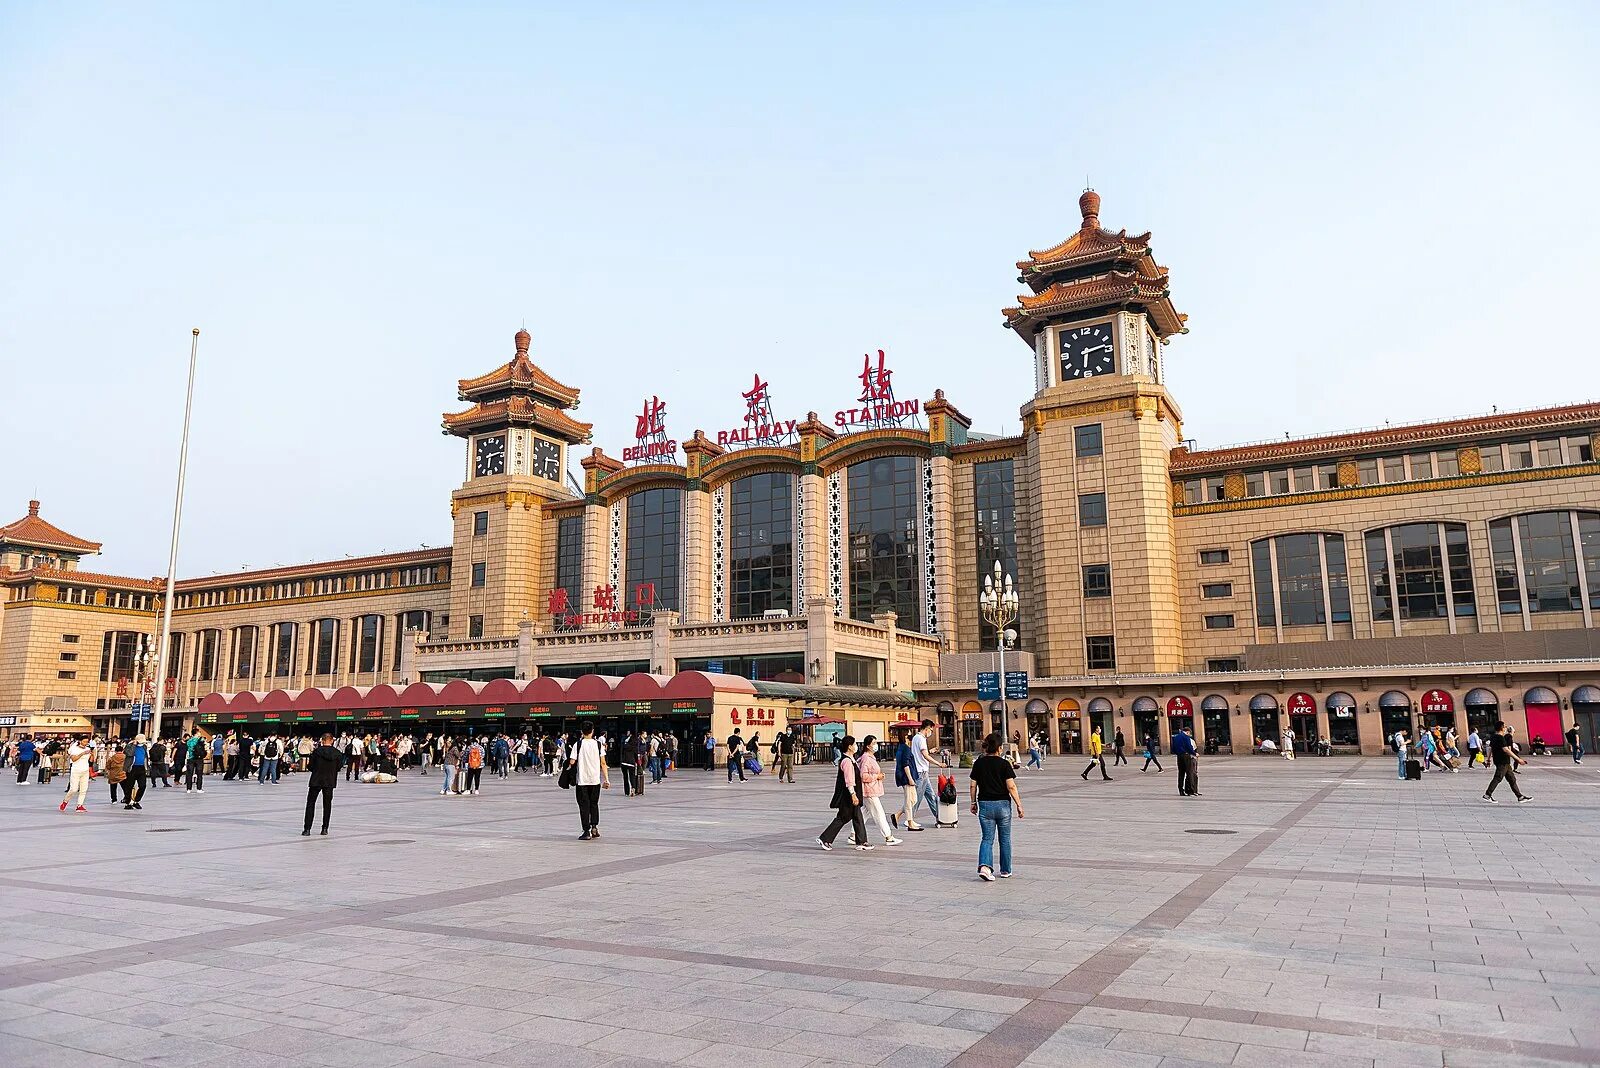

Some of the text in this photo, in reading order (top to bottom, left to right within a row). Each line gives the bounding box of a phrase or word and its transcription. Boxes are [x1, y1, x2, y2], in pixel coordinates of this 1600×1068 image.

[1081, 327, 1091, 335] 12
[1105, 345, 1113, 353] 3
[635, 395, 666, 439] 北
[622, 399, 919, 461] BEIJING RAILWAY STATION
[564, 610, 638, 625] ENTRANCE
